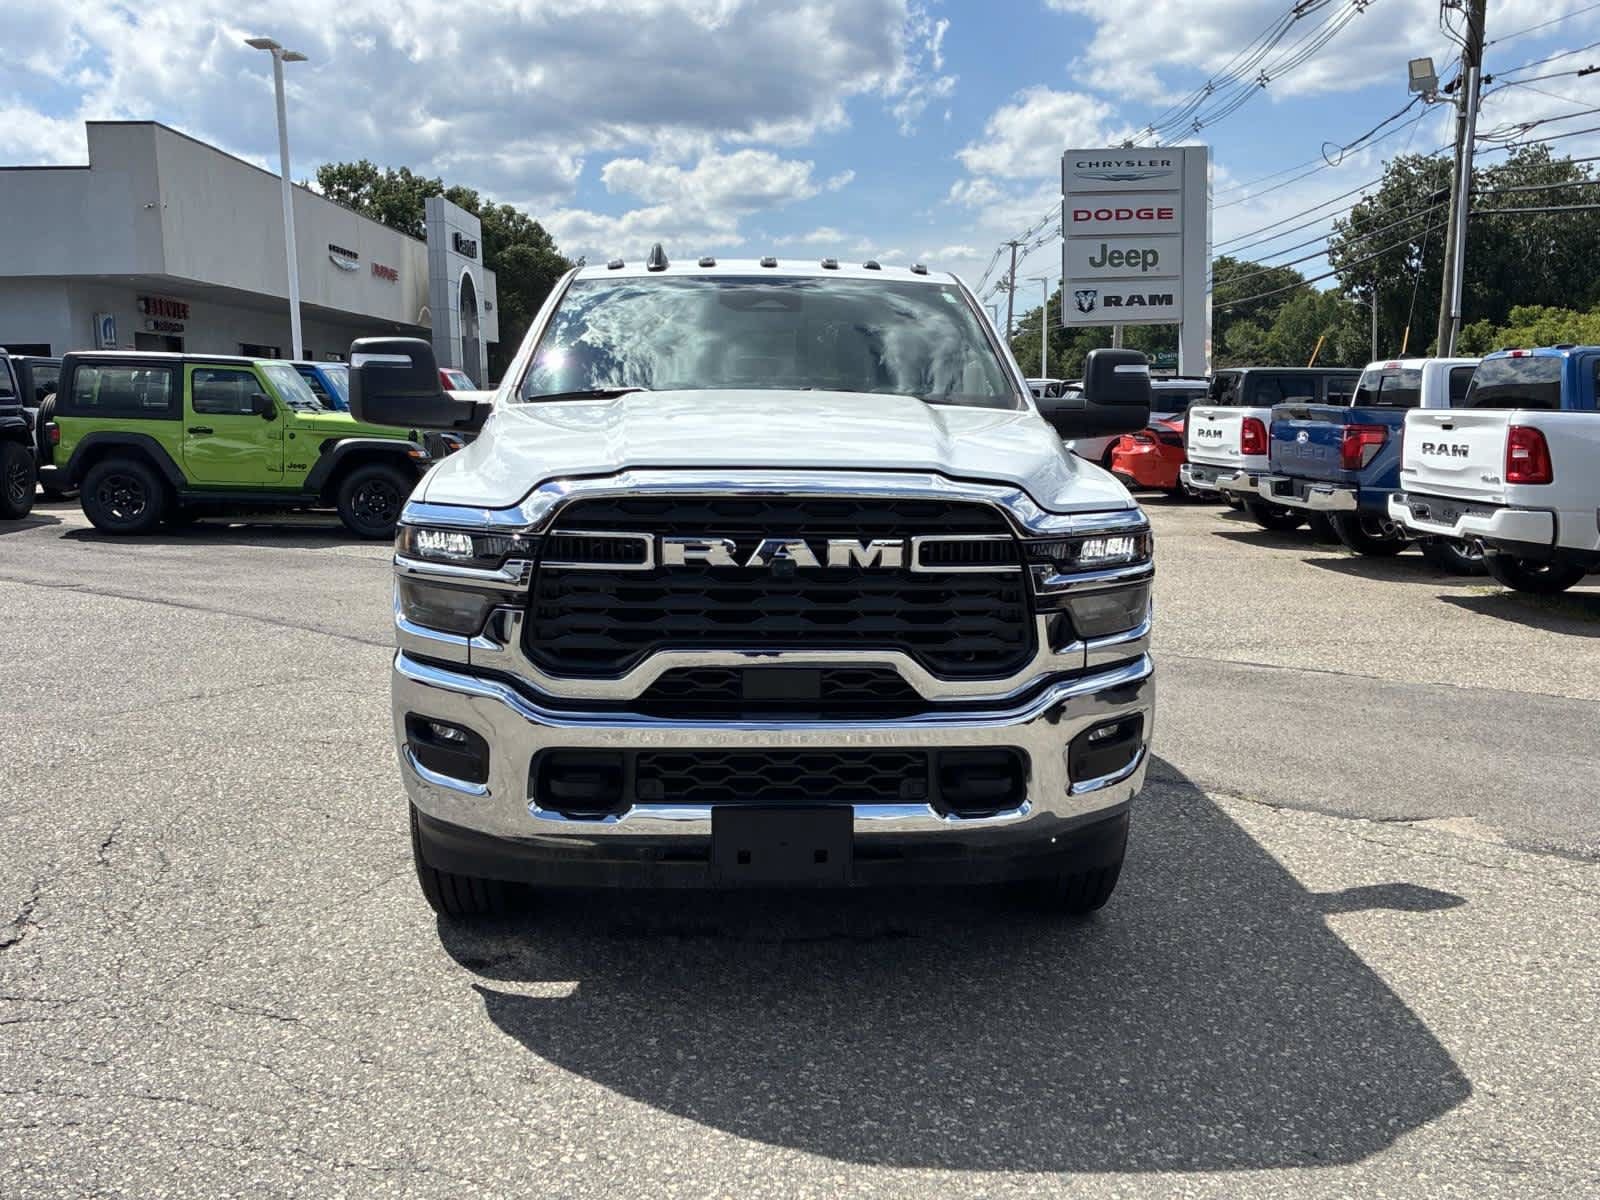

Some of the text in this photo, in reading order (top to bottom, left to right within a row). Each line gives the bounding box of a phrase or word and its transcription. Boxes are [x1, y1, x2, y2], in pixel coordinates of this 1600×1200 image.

[1075, 159, 1171, 169] CHRYSLER
[1073, 208, 1174, 222] DODGE
[1089, 243, 1159, 272] Jeep
[1103, 294, 1174, 308] RAM
[1197, 428, 1223, 439] RAM
[1422, 442, 1470, 458] RAM
[287, 462, 307, 470] Jeep
[661, 536, 905, 568] RAM
